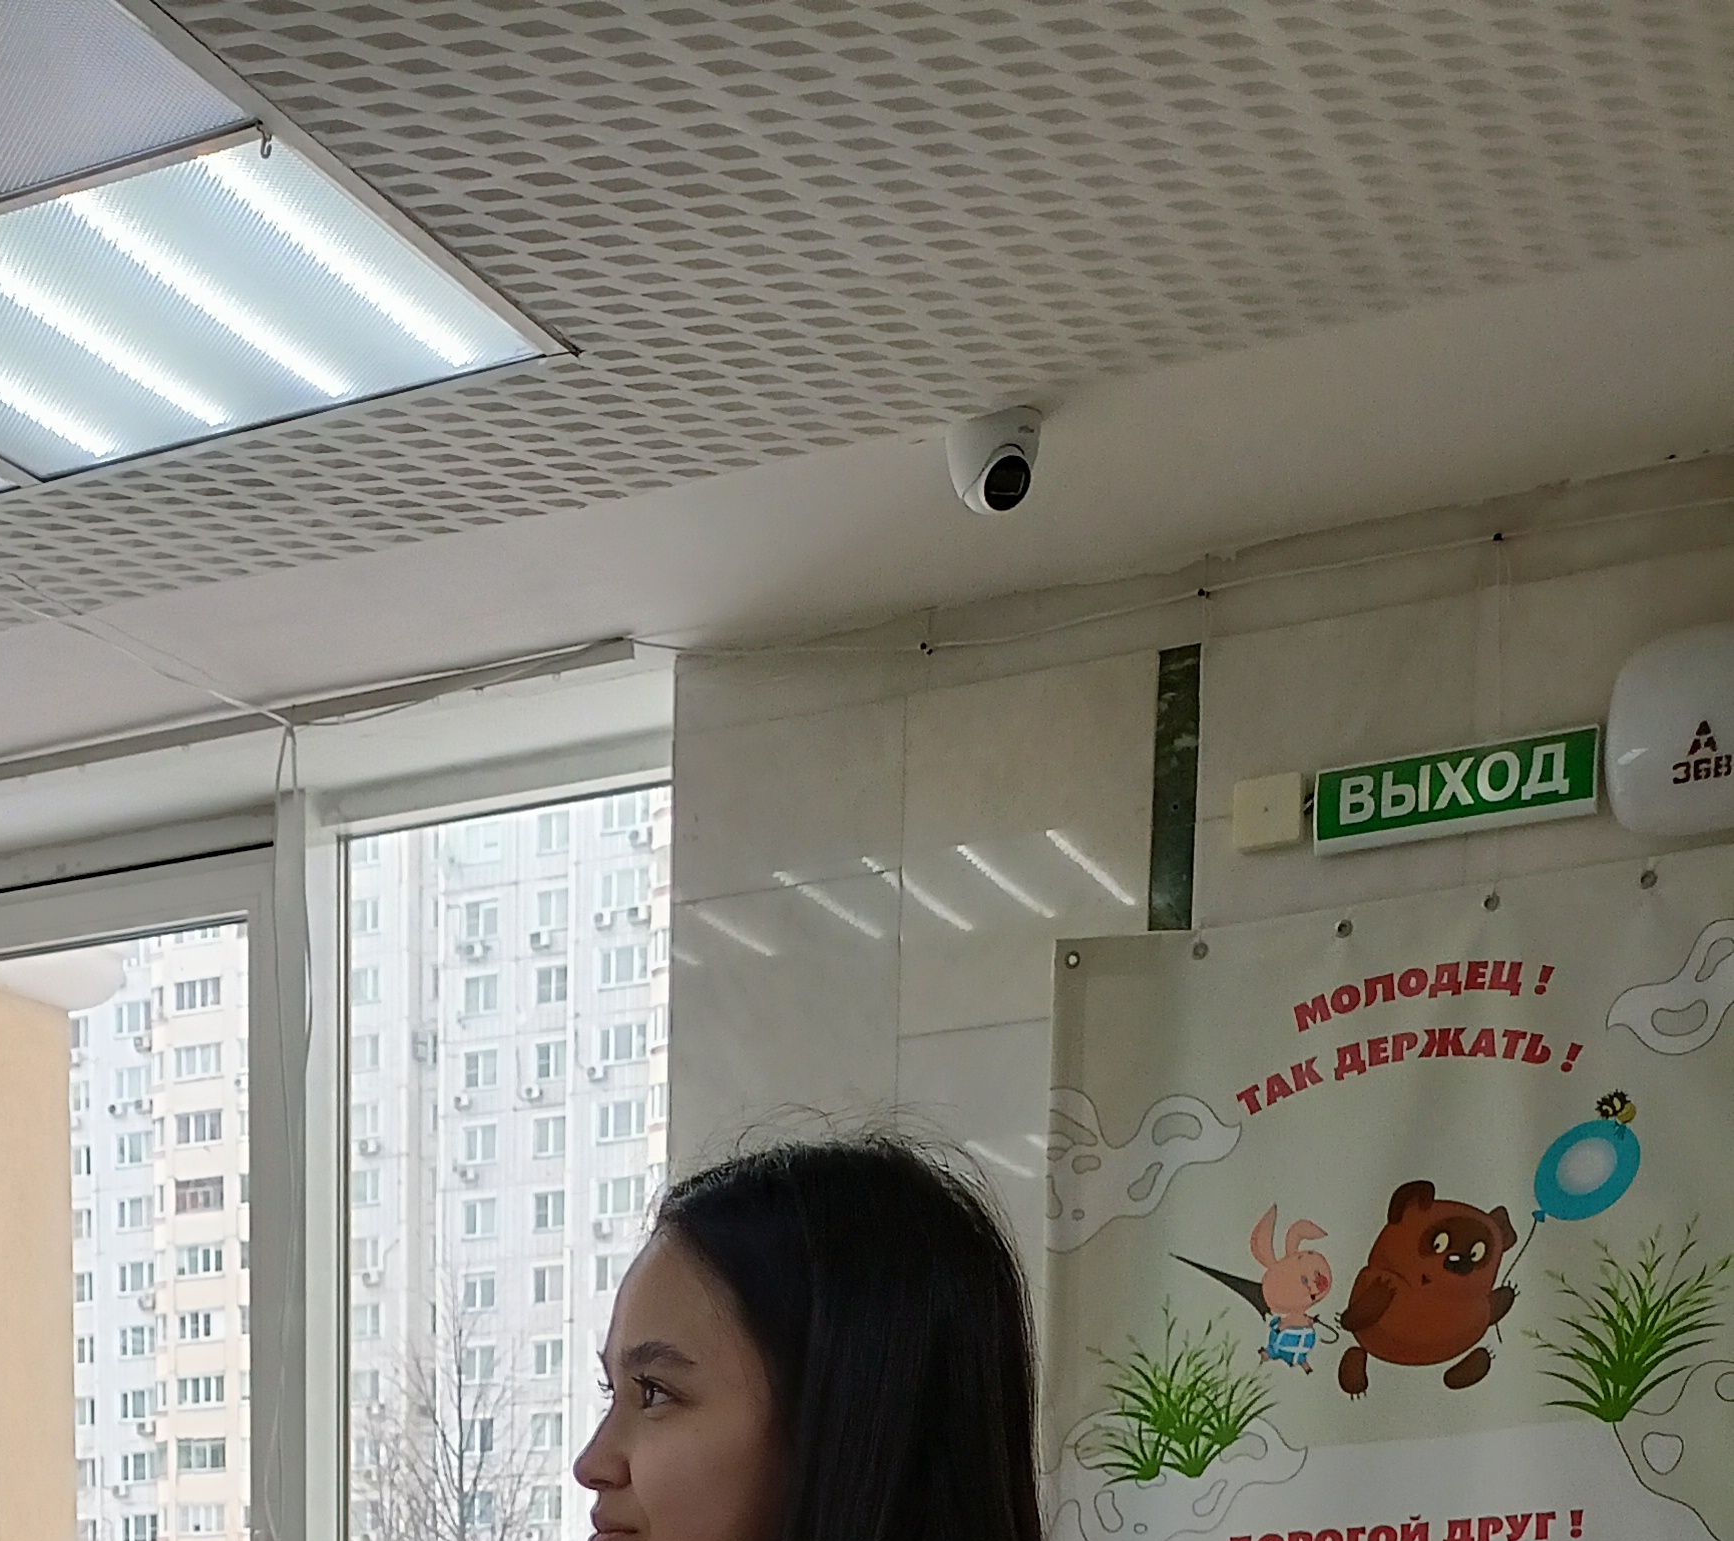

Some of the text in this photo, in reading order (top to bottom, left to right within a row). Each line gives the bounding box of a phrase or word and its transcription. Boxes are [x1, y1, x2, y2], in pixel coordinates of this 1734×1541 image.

[1338, 741, 1572, 827] ВЫХОД
[1293, 960, 1523, 1033] МОЛОДЕЦ
[1235, 1056, 1324, 1116] ТАК
[1333, 1027, 1552, 1080] ДЕРЖАТЬ
